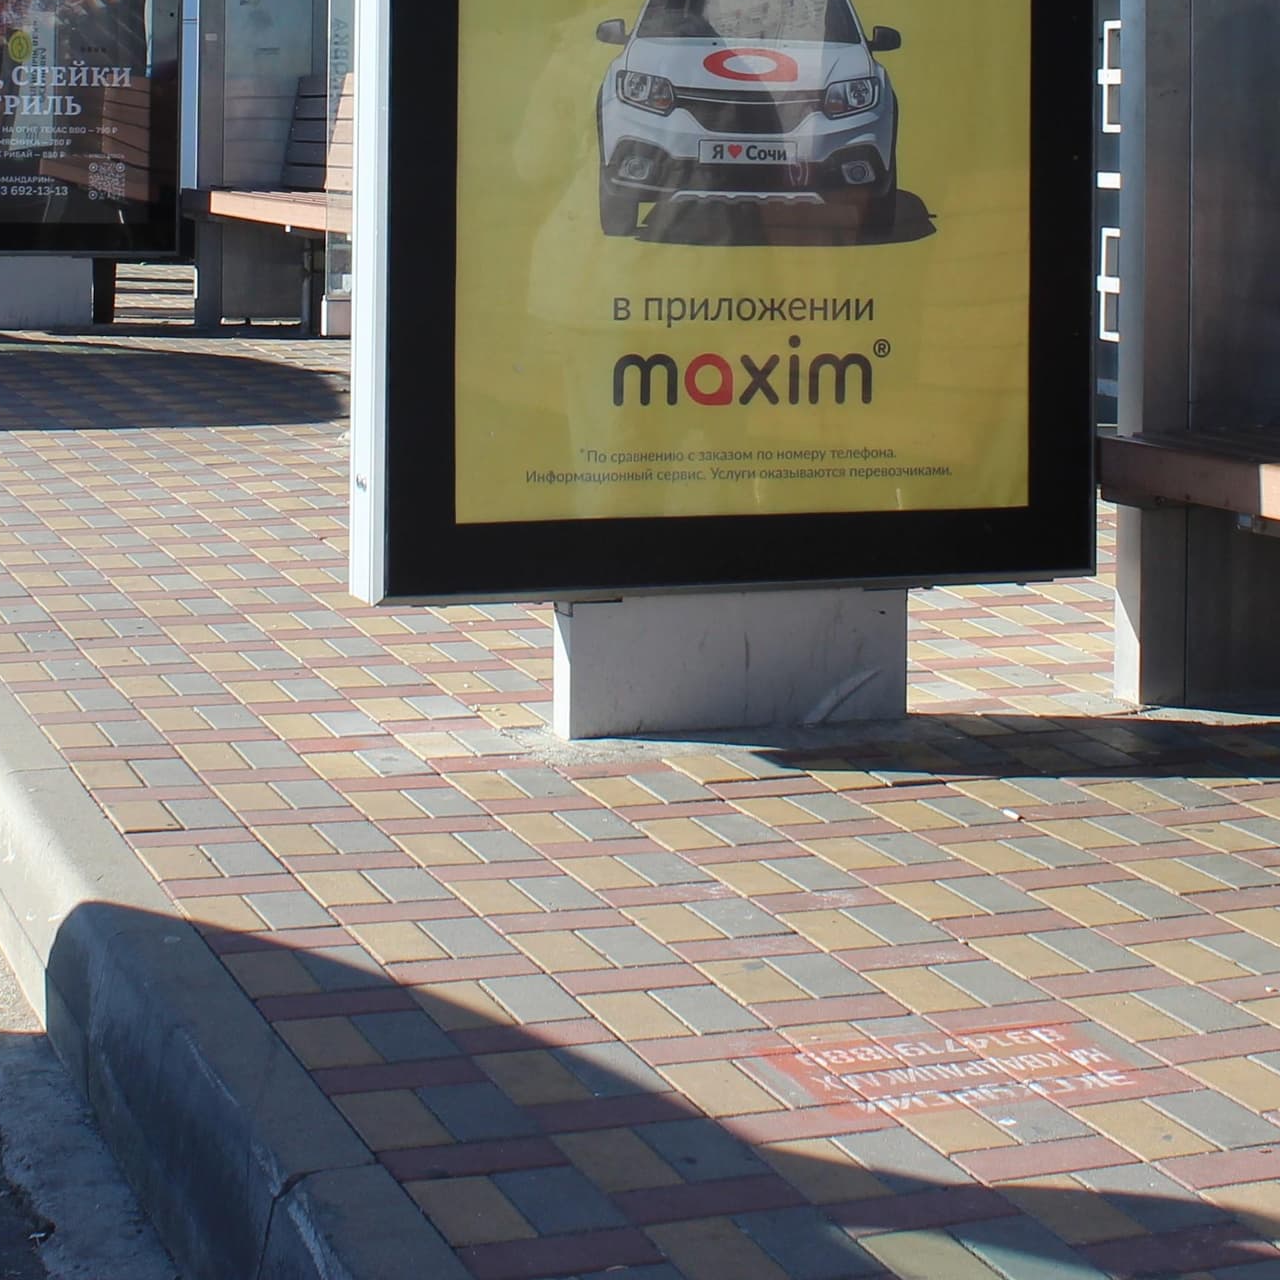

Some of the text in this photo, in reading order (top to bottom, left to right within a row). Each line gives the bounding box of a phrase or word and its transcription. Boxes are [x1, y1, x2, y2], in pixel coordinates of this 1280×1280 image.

[11, 60, 132, 88] СТЕЙКИ
[711, 144, 788, 161] Я Сочи
[10, 186, 69, 196] 692-13-13
[613, 291, 876, 329] в приложении
[610, 450, 685, 467] сравнению
[698, 450, 753, 461] заказом
[757, 450, 774, 461] по
[776, 449, 826, 464] номеру
[830, 447, 897, 462] телефона.
[525, 464, 953, 485] Информационный сервис. Услуги оказываются перевозчиками.
